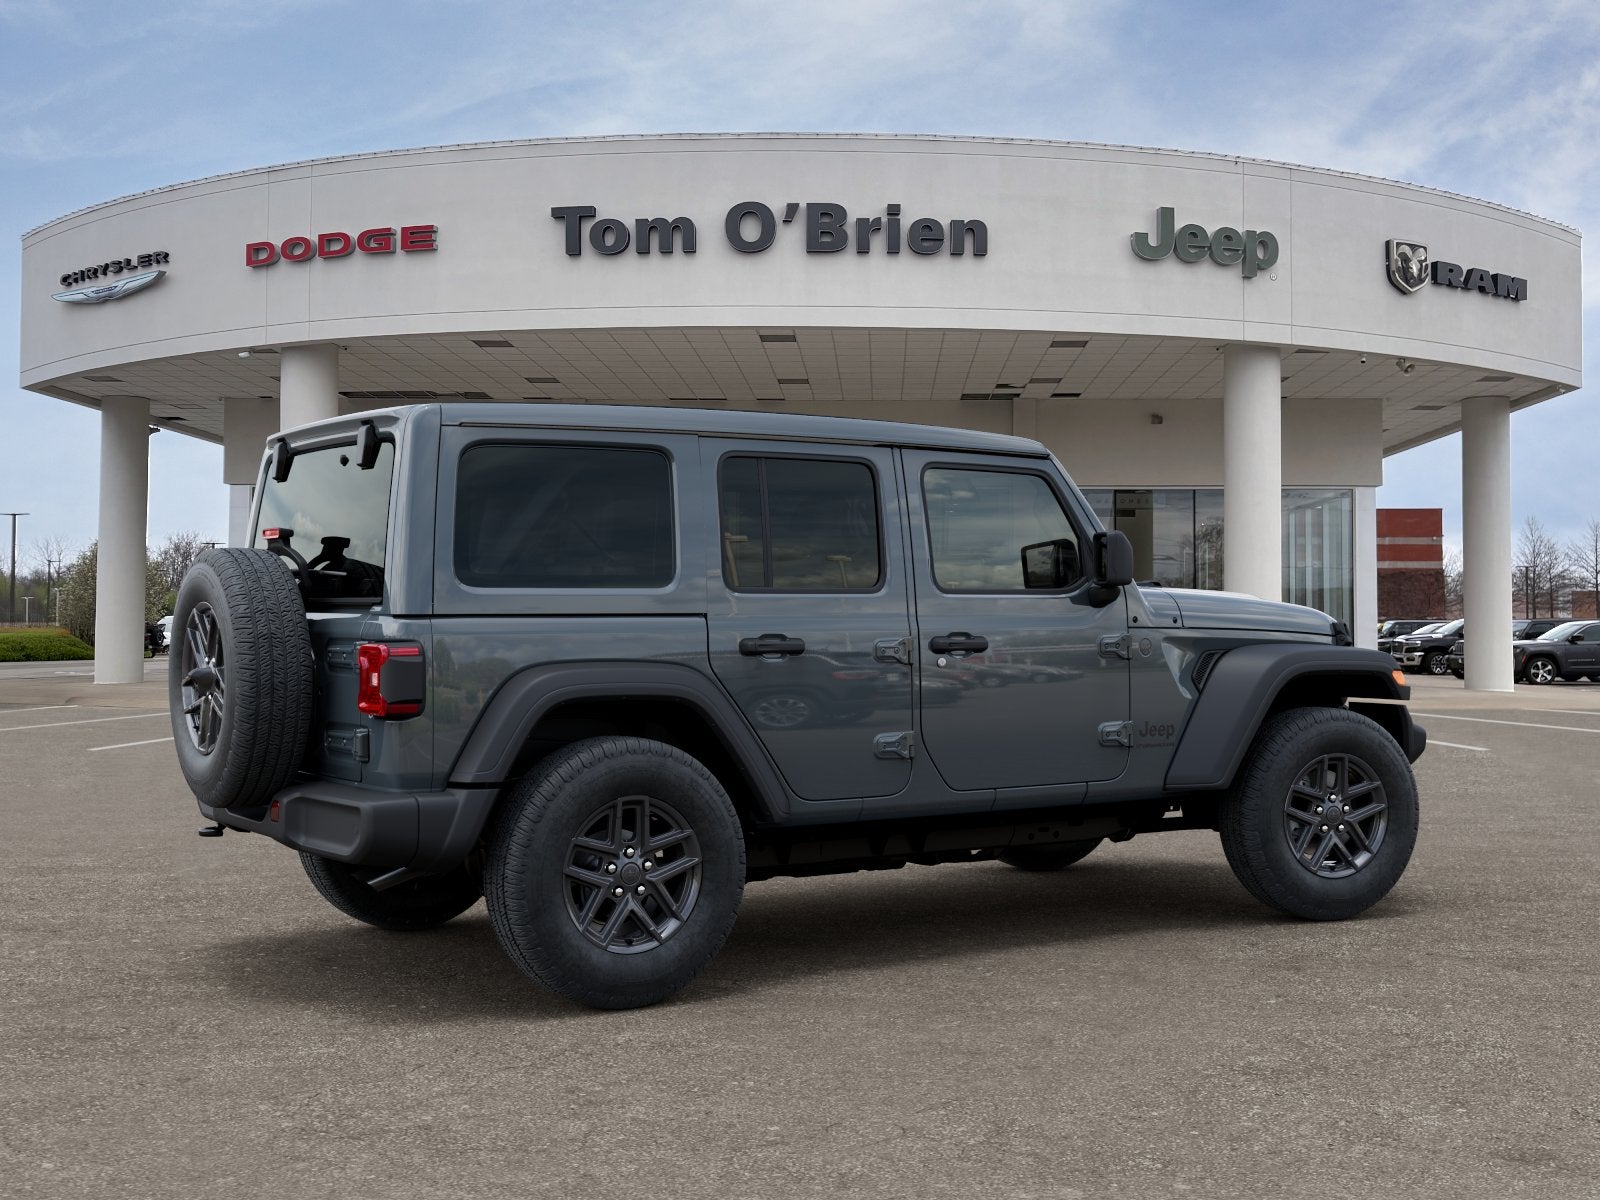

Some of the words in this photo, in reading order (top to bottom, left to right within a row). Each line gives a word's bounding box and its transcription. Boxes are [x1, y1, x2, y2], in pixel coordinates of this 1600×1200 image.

[245, 224, 438, 268] DODGE
[550, 205, 697, 256] Tom
[724, 201, 988, 256] O'Brien
[1130, 206, 1279, 278] Jeep
[60, 250, 170, 287] CHRYSLER
[1431, 260, 1528, 301] RAM
[1139, 721, 1175, 739] Jeep
